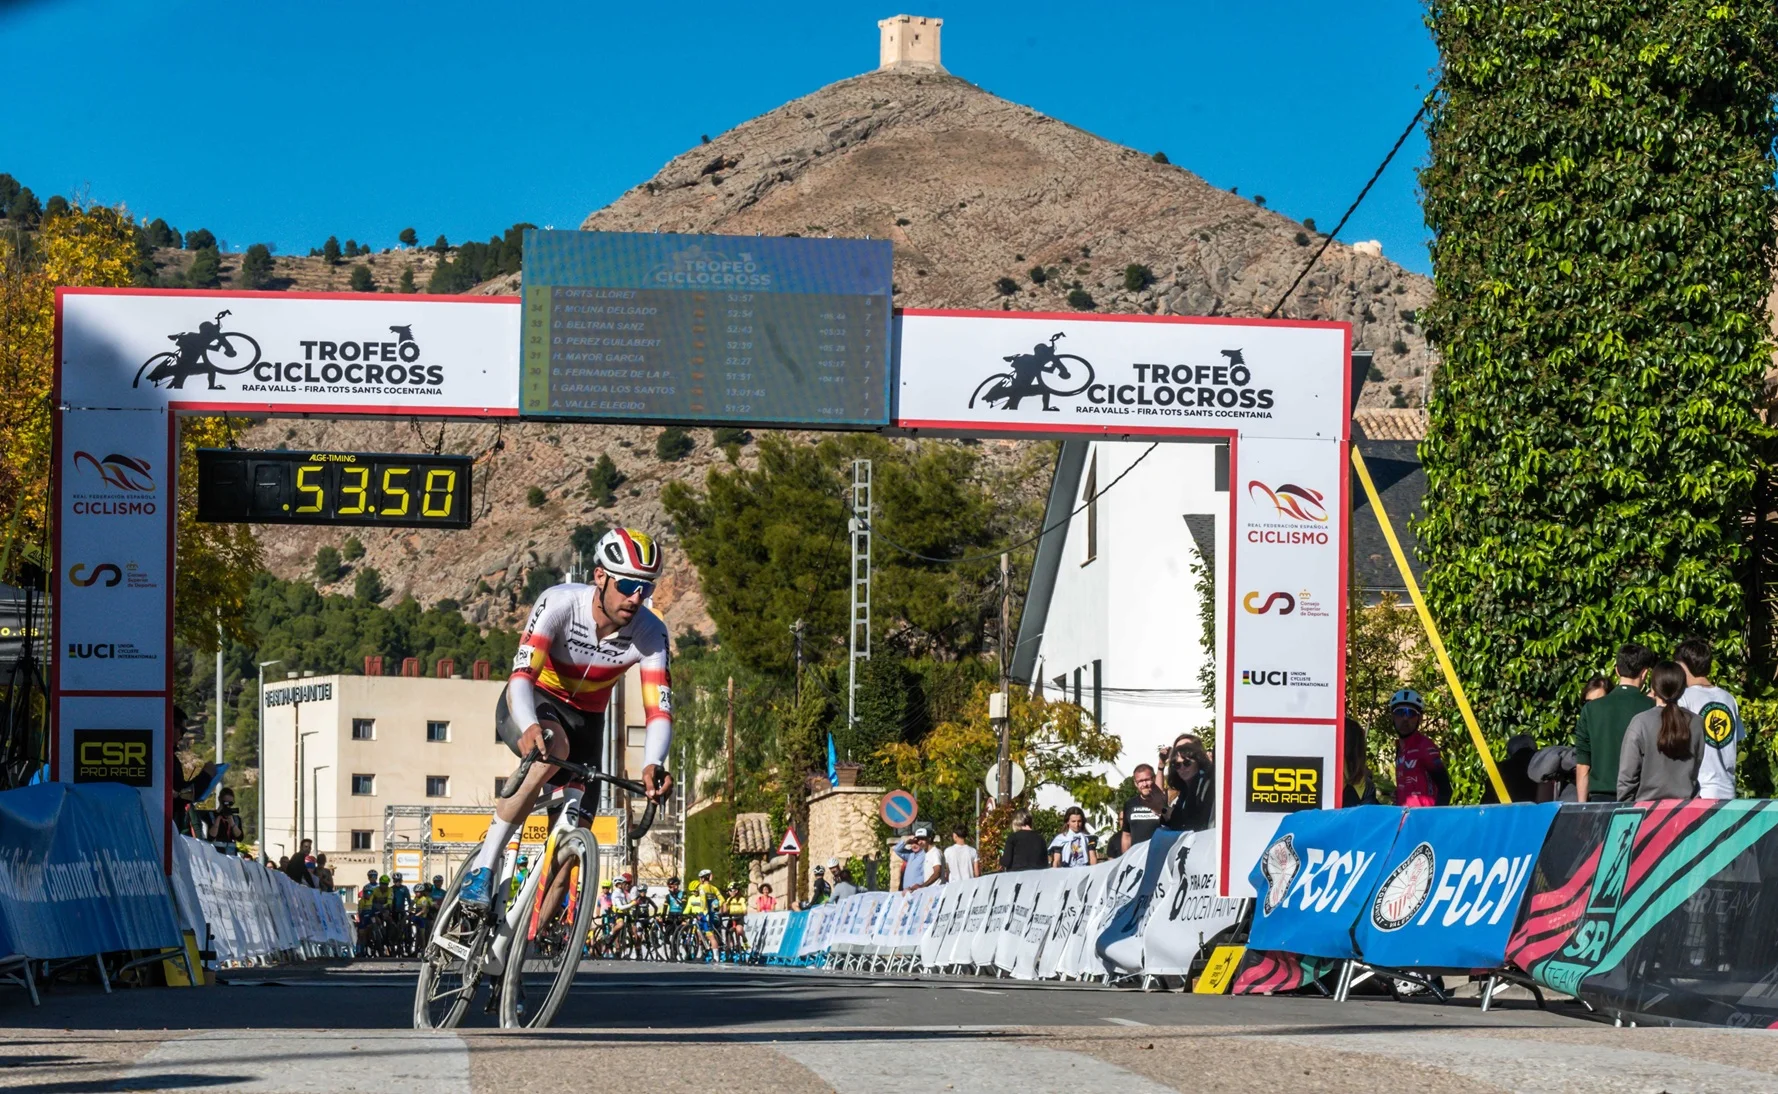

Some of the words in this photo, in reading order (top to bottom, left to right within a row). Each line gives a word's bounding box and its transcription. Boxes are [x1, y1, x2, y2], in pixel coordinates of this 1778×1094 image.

[684, 260, 757, 272] TROFEO
[655, 271, 772, 284] CICLOCROSS
[565, 290, 593, 298] ORTS
[596, 291, 637, 299] LLORET
[564, 306, 604, 314] MOLINA
[607, 306, 658, 315] DELGADO
[554, 320, 564, 329] D.
[566, 321, 615, 330] BELTRAN
[616, 322, 645, 332] SANZ
[554, 337, 564, 346] D.
[566, 338, 600, 346] PEREZ
[602, 338, 662, 347] GUILABERT
[299, 340, 420, 363] TROFEO
[552, 353, 562, 361] H.
[566, 353, 603, 362] MAYOR
[606, 354, 645, 362] GARCIA
[726, 358, 752, 366] 52:27
[253, 361, 445, 386] CICLOCROSS
[552, 368, 562, 376] B.
[566, 369, 627, 378] FERNANDEZ
[630, 370, 645, 378] DE
[647, 371, 660, 379] LA
[1132, 363, 1251, 387] TROFEO
[242, 384, 267, 392] RAFA
[268, 384, 297, 393] VALLS
[304, 385, 326, 393] FIRA
[327, 386, 350, 394] TOTS
[352, 386, 382, 394] SANTS
[383, 387, 443, 396] COCENTANIA
[610, 386, 631, 394] LOS
[634, 386, 676, 395] SANTOS
[1087, 384, 1274, 410] CICLOCROSS
[552, 400, 562, 408] A.
[565, 401, 598, 410] VALLE
[600, 401, 646, 410] ELEGIDO
[1101, 406, 1130, 414] VALLS
[1137, 408, 1158, 416] FIRA
[1159, 408, 1182, 416] TOTS
[1184, 409, 1214, 417] SANTS
[1214, 410, 1273, 418] COCENTANIA
[73, 502, 156, 515] CICLISMO
[1248, 530, 1328, 545] CICLISMO
[77, 644, 115, 658] UCI
[567, 638, 625, 657] RIDLEY
[1250, 670, 1288, 686] UCI
[80, 742, 146, 766] CSR
[80, 767, 108, 778] PRO
[110, 767, 146, 778] RACE
[1252, 767, 1316, 792] CSR
[1252, 792, 1282, 804] PRO
[1284, 794, 1316, 805] RACE
[1418, 853, 1534, 927] FCCV
[1562, 920, 1610, 962] SR
